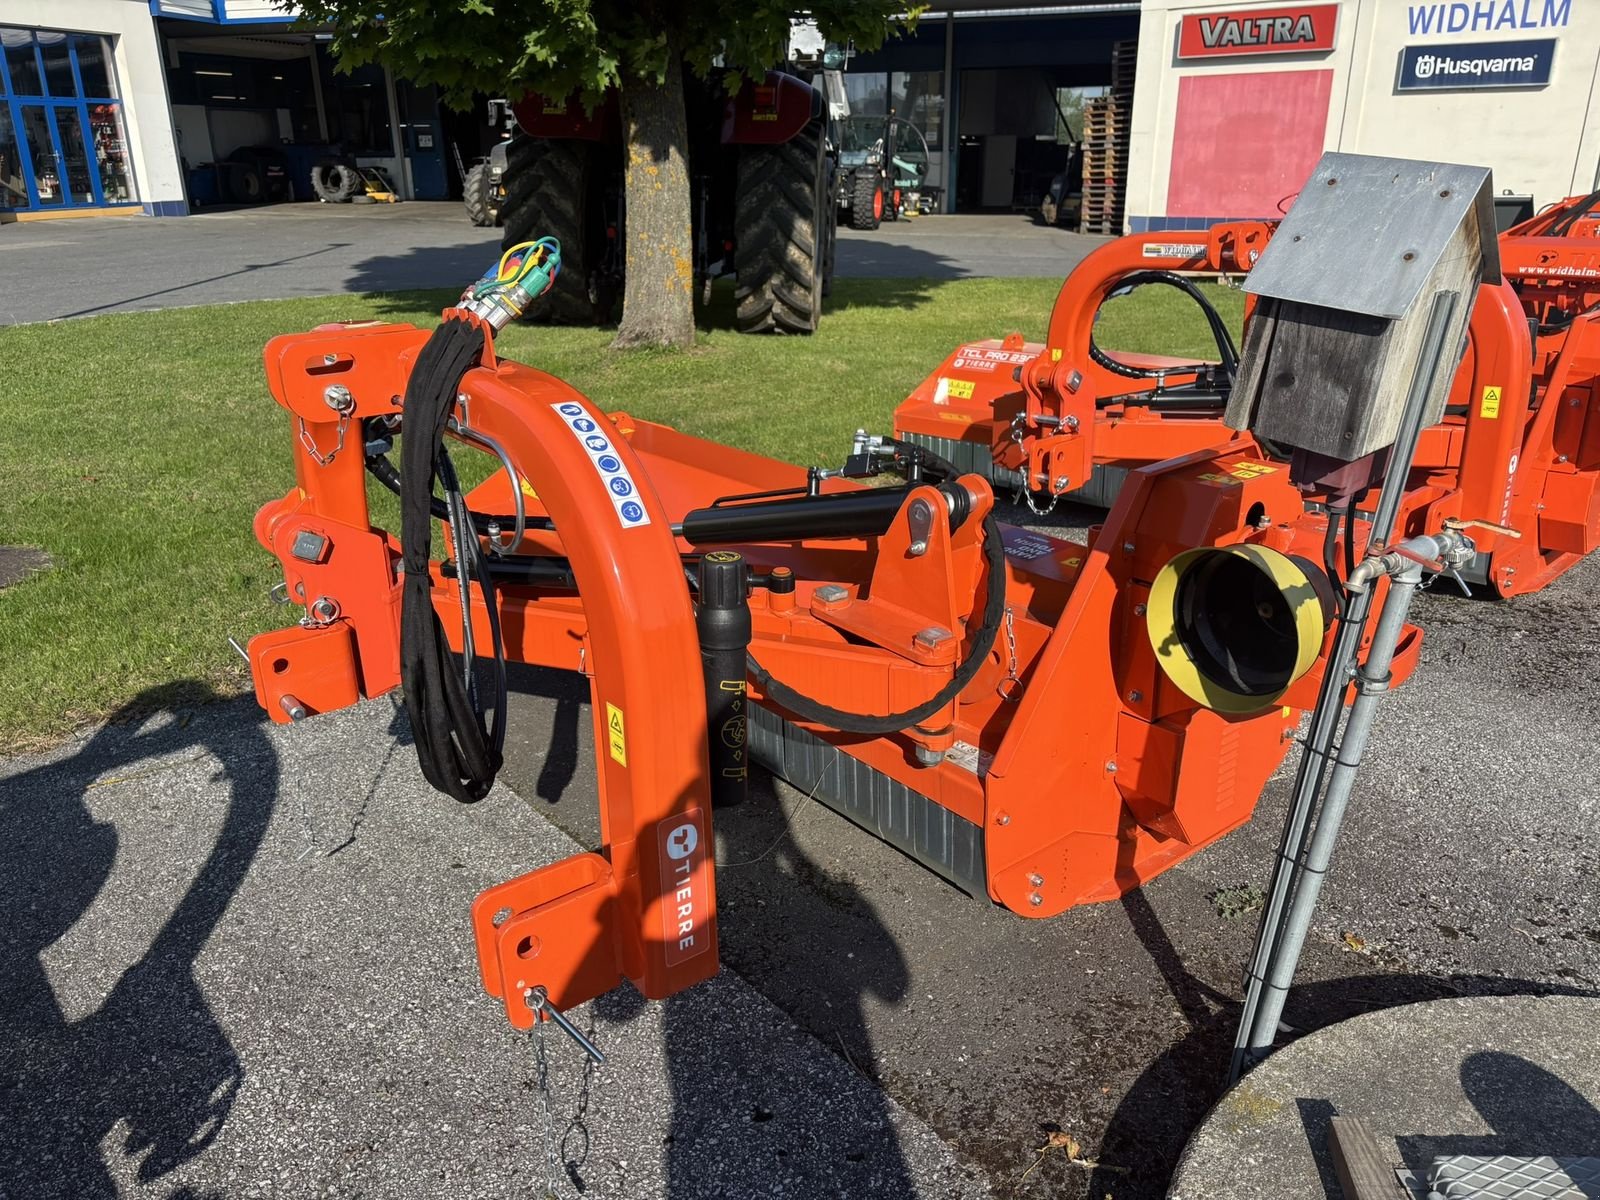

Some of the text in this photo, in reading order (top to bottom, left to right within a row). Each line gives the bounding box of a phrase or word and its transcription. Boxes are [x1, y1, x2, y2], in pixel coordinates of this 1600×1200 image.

[1199, 14, 1316, 49] VALTRA
[1408, 0, 1572, 35] WIDHALM
[1435, 56, 1535, 77] Husqvarna
[963, 349, 983, 358] TCL
[984, 351, 1010, 360] PRO
[965, 360, 996, 368] TIERRE
[676, 860, 694, 950] TIERRE
